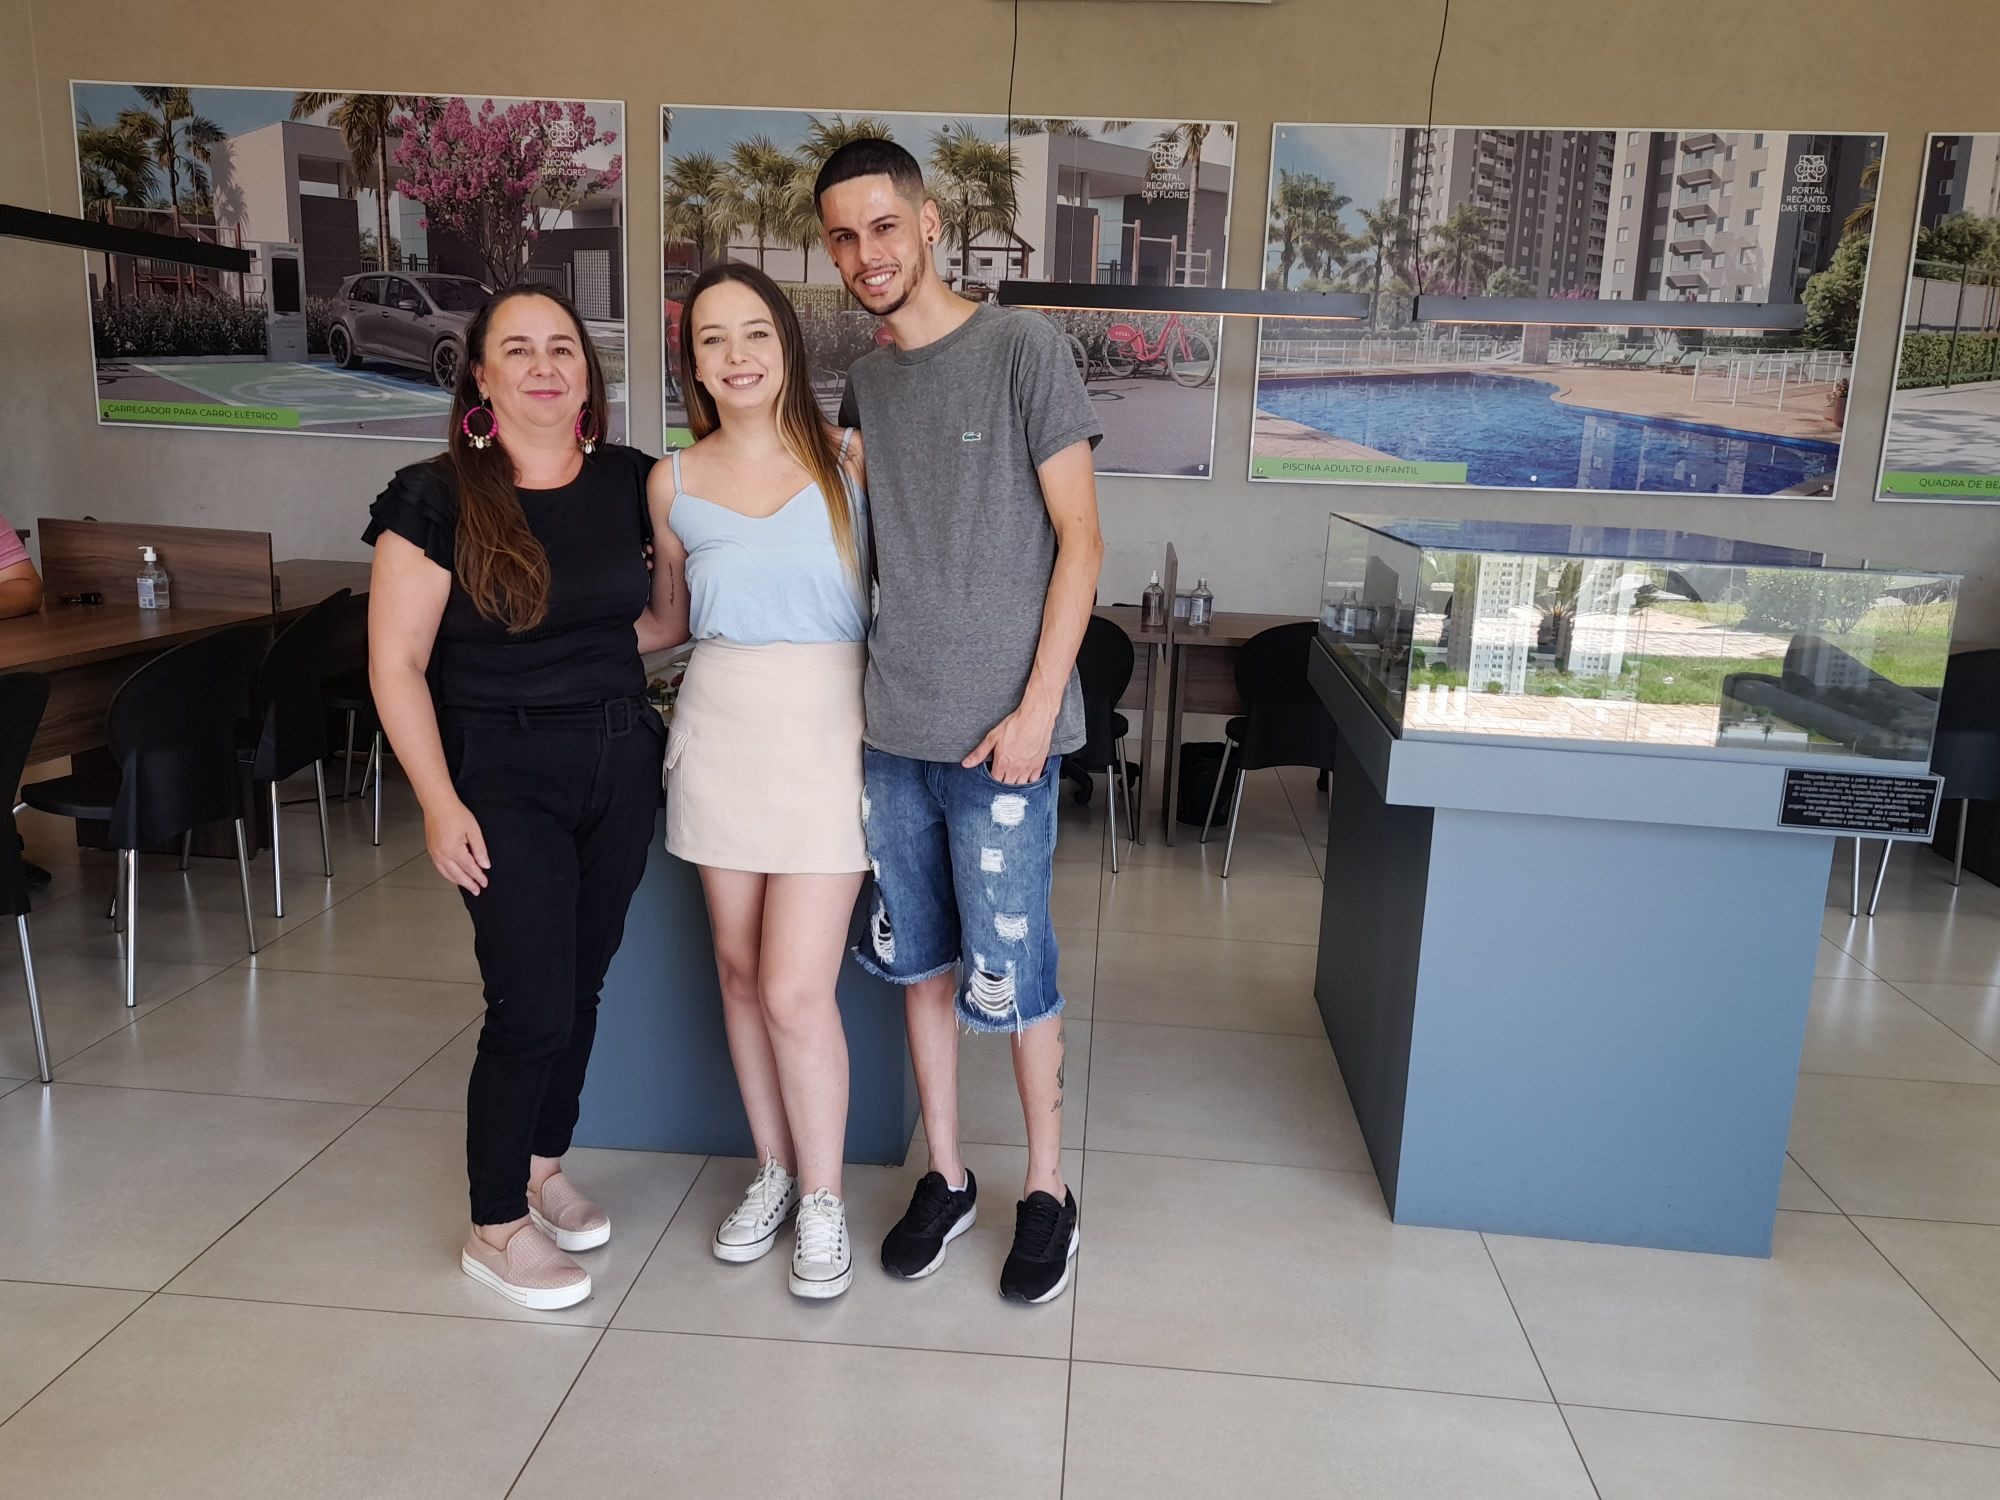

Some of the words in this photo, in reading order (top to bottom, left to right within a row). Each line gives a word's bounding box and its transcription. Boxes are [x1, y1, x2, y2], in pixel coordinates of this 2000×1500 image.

[542, 168, 557, 176] DAS
[558, 168, 587, 177] FLORES
[1151, 172, 1182, 181] PORTAL
[1146, 182, 1186, 190] RECANTO
[1142, 190, 1158, 198] DAS
[1160, 191, 1189, 199] FLORES
[1786, 195, 1828, 204] RECANTO
[1800, 204, 1831, 213] FLORES
[108, 404, 171, 415] CARREGADOR
[174, 407, 198, 416] PARA
[200, 409, 232, 418] CARRO
[1282, 462, 1322, 472] PISCINA
[1323, 464, 1364, 473] ADULTO
[1366, 465, 1372, 474] E
[1374, 465, 1419, 475] INFANTIL
[1919, 478, 1965, 488] QUADRA
[1967, 480, 1983, 489] DE
[1985, 480, 2000, 489] BE
